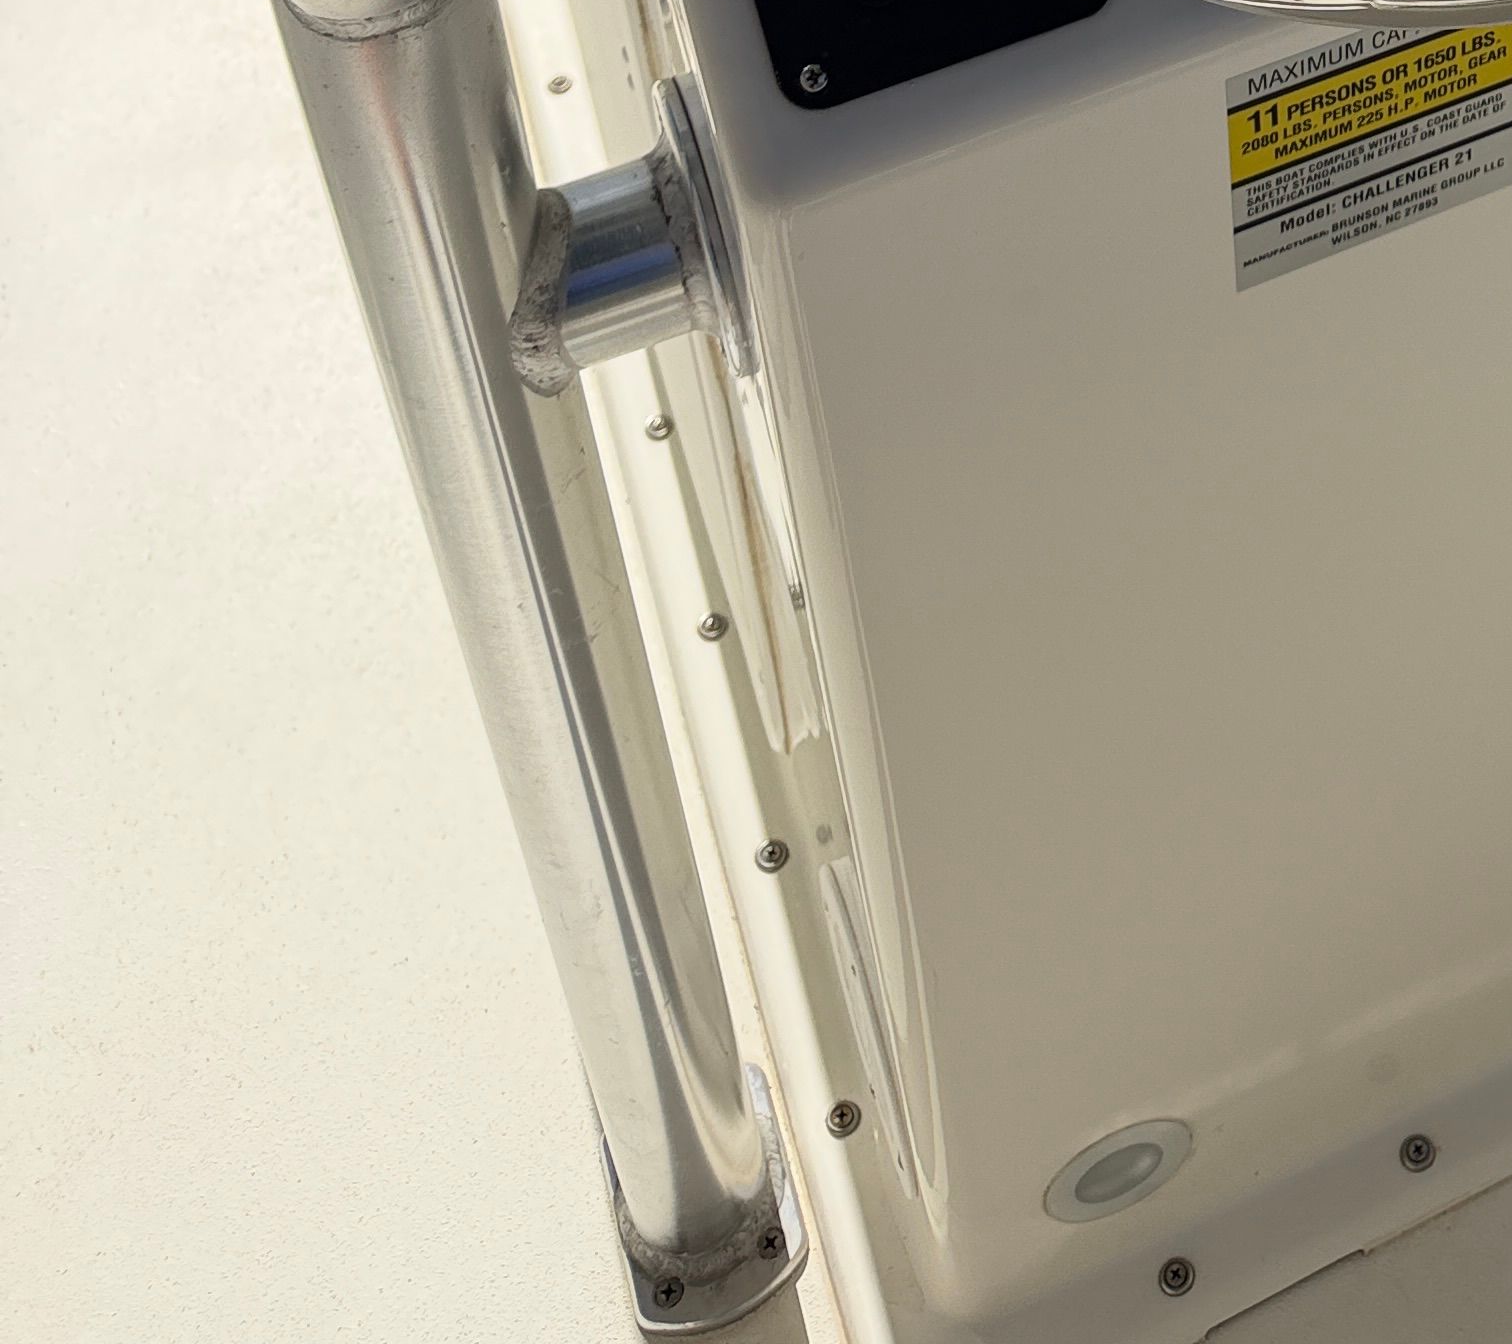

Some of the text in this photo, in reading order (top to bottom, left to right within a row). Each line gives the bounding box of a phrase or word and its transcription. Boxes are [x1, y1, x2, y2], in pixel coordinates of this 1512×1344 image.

[1247, 31, 1502, 134] 11 PERSONS OR 1650 LBS.
[1248, 37, 1364, 95] MAXIMUM
[1283, 118, 1317, 140] LBS.
[1323, 87, 1399, 125] PERSONS,
[1404, 64, 1463, 94] MOTOR,
[1468, 46, 1507, 70] GEAR
[1245, 180, 1272, 197] THIS
[1275, 167, 1304, 186] BOAT
[1308, 144, 1365, 173] COMPLIES
[1368, 133, 1397, 151] WITH
[1427, 108, 1462, 128] COAST
[1465, 92, 1503, 114] GUARD
[1246, 100, 1507, 208] SAFETY STANDARDS IN EFFECT ON THE DATE OF
[1274, 73, 1478, 160] MAXIMUM 225 H.P. MOTOR
[1280, 148, 1472, 233] Model: CHALLENGER 21
[1331, 202, 1389, 233] BRUNSON
[1392, 183, 1438, 210] MARINE
[1441, 167, 1481, 190] GROUP
[1484, 157, 1505, 173] LLC
[1386, 211, 1401, 225] NC
